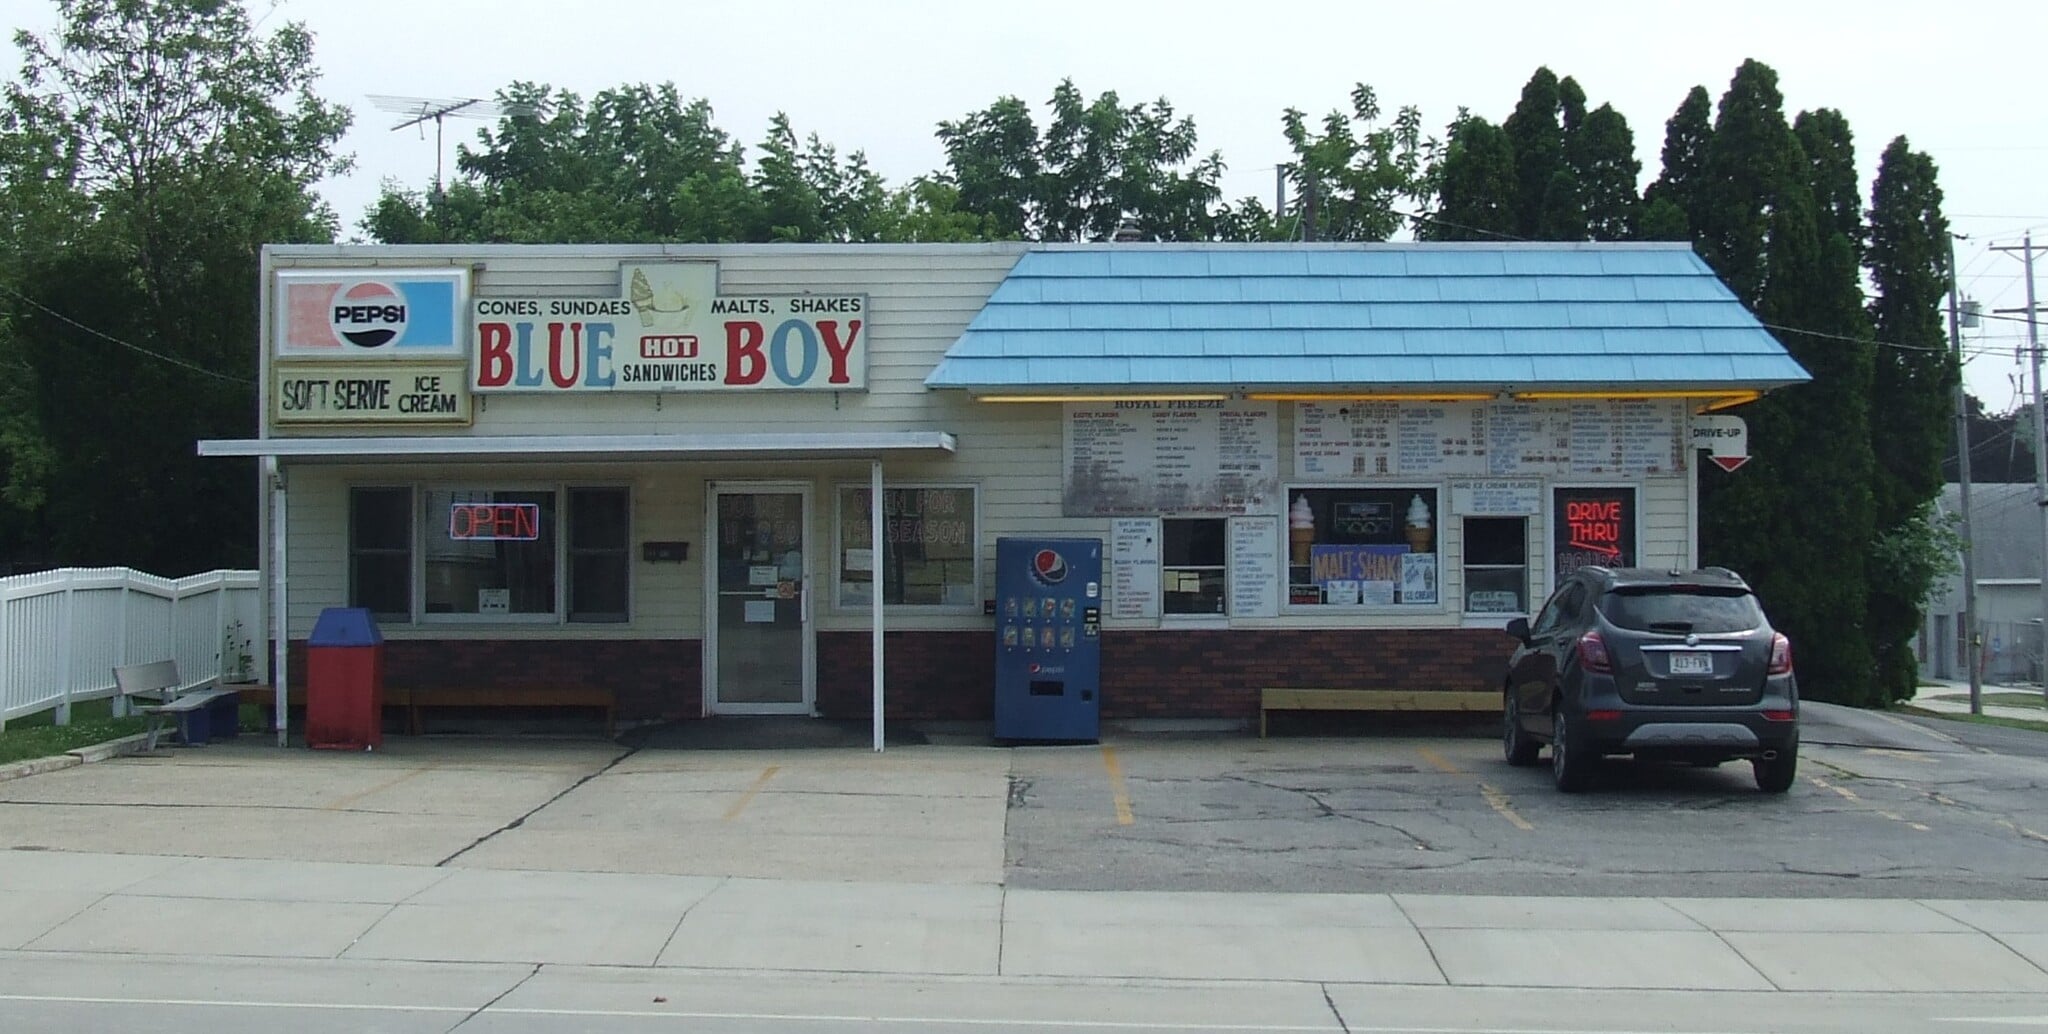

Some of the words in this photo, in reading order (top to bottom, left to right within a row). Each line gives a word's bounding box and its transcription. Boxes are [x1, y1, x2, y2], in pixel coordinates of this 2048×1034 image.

[334, 305, 406, 324] PEPSI
[478, 300, 543, 317] CONES,
[551, 300, 631, 317] SUNDAES
[710, 299, 775, 316] MALTS,
[790, 298, 861, 313] SHAKES
[478, 321, 616, 389] BLUE
[724, 319, 861, 386] BOY
[644, 338, 696, 356] HOT
[623, 363, 717, 382] SANDWICHES
[415, 377, 440, 393] ICE
[282, 380, 329, 411] SOFT
[333, 380, 391, 411] SERVE
[398, 394, 457, 413] CREAM
[1115, 400, 1160, 409] ROYAL
[1168, 400, 1225, 409] FREEZE
[1693, 428, 1741, 437] DRIVE-UP
[1567, 502, 1621, 520] DRIVE
[454, 505, 537, 537] OPEN
[887, 519, 966, 545] SEASON
[1569, 523, 1618, 541] THRU
[1404, 590, 1413, 600] ICE
[1414, 590, 1435, 600] CREAM
